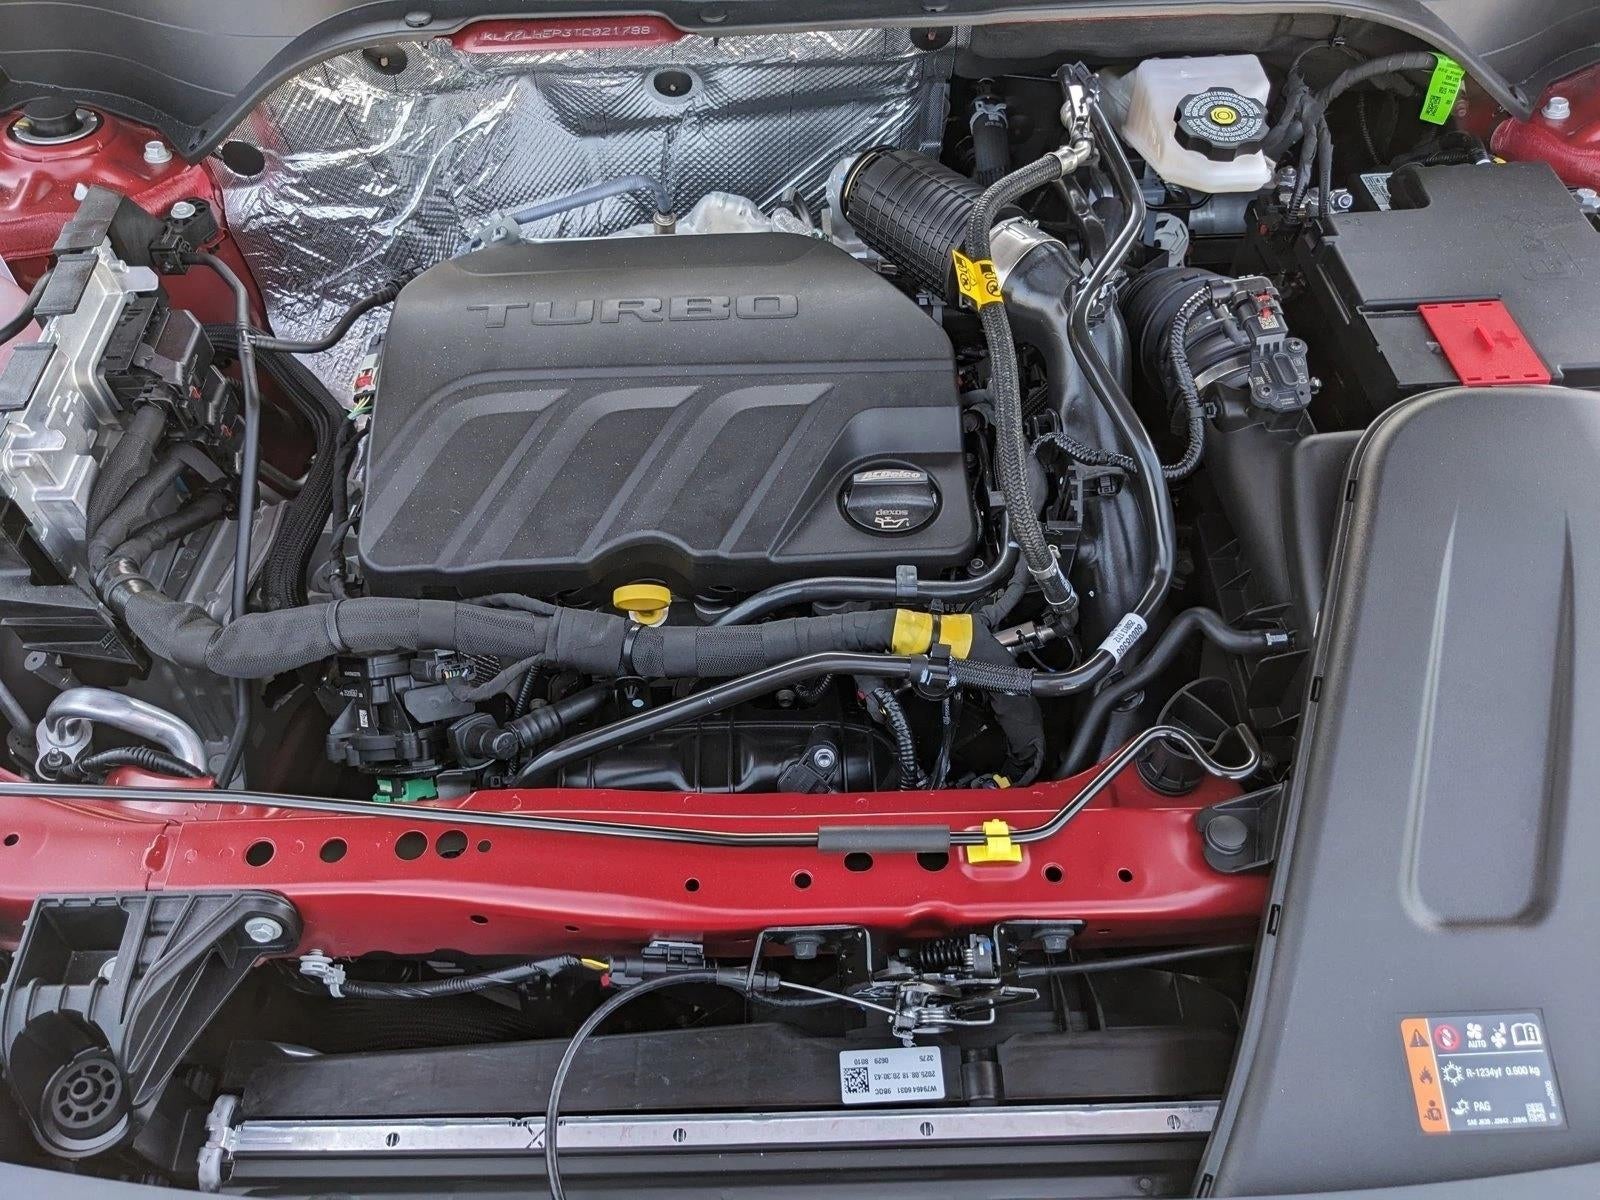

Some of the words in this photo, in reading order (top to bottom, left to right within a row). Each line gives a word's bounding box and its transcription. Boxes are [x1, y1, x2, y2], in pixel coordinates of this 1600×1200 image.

[467, 295, 799, 328] TURBO
[1468, 1040, 1487, 1048] AUTO
[1528, 1065, 1541, 1077] kg
[1473, 1102, 1492, 1112] PAG
